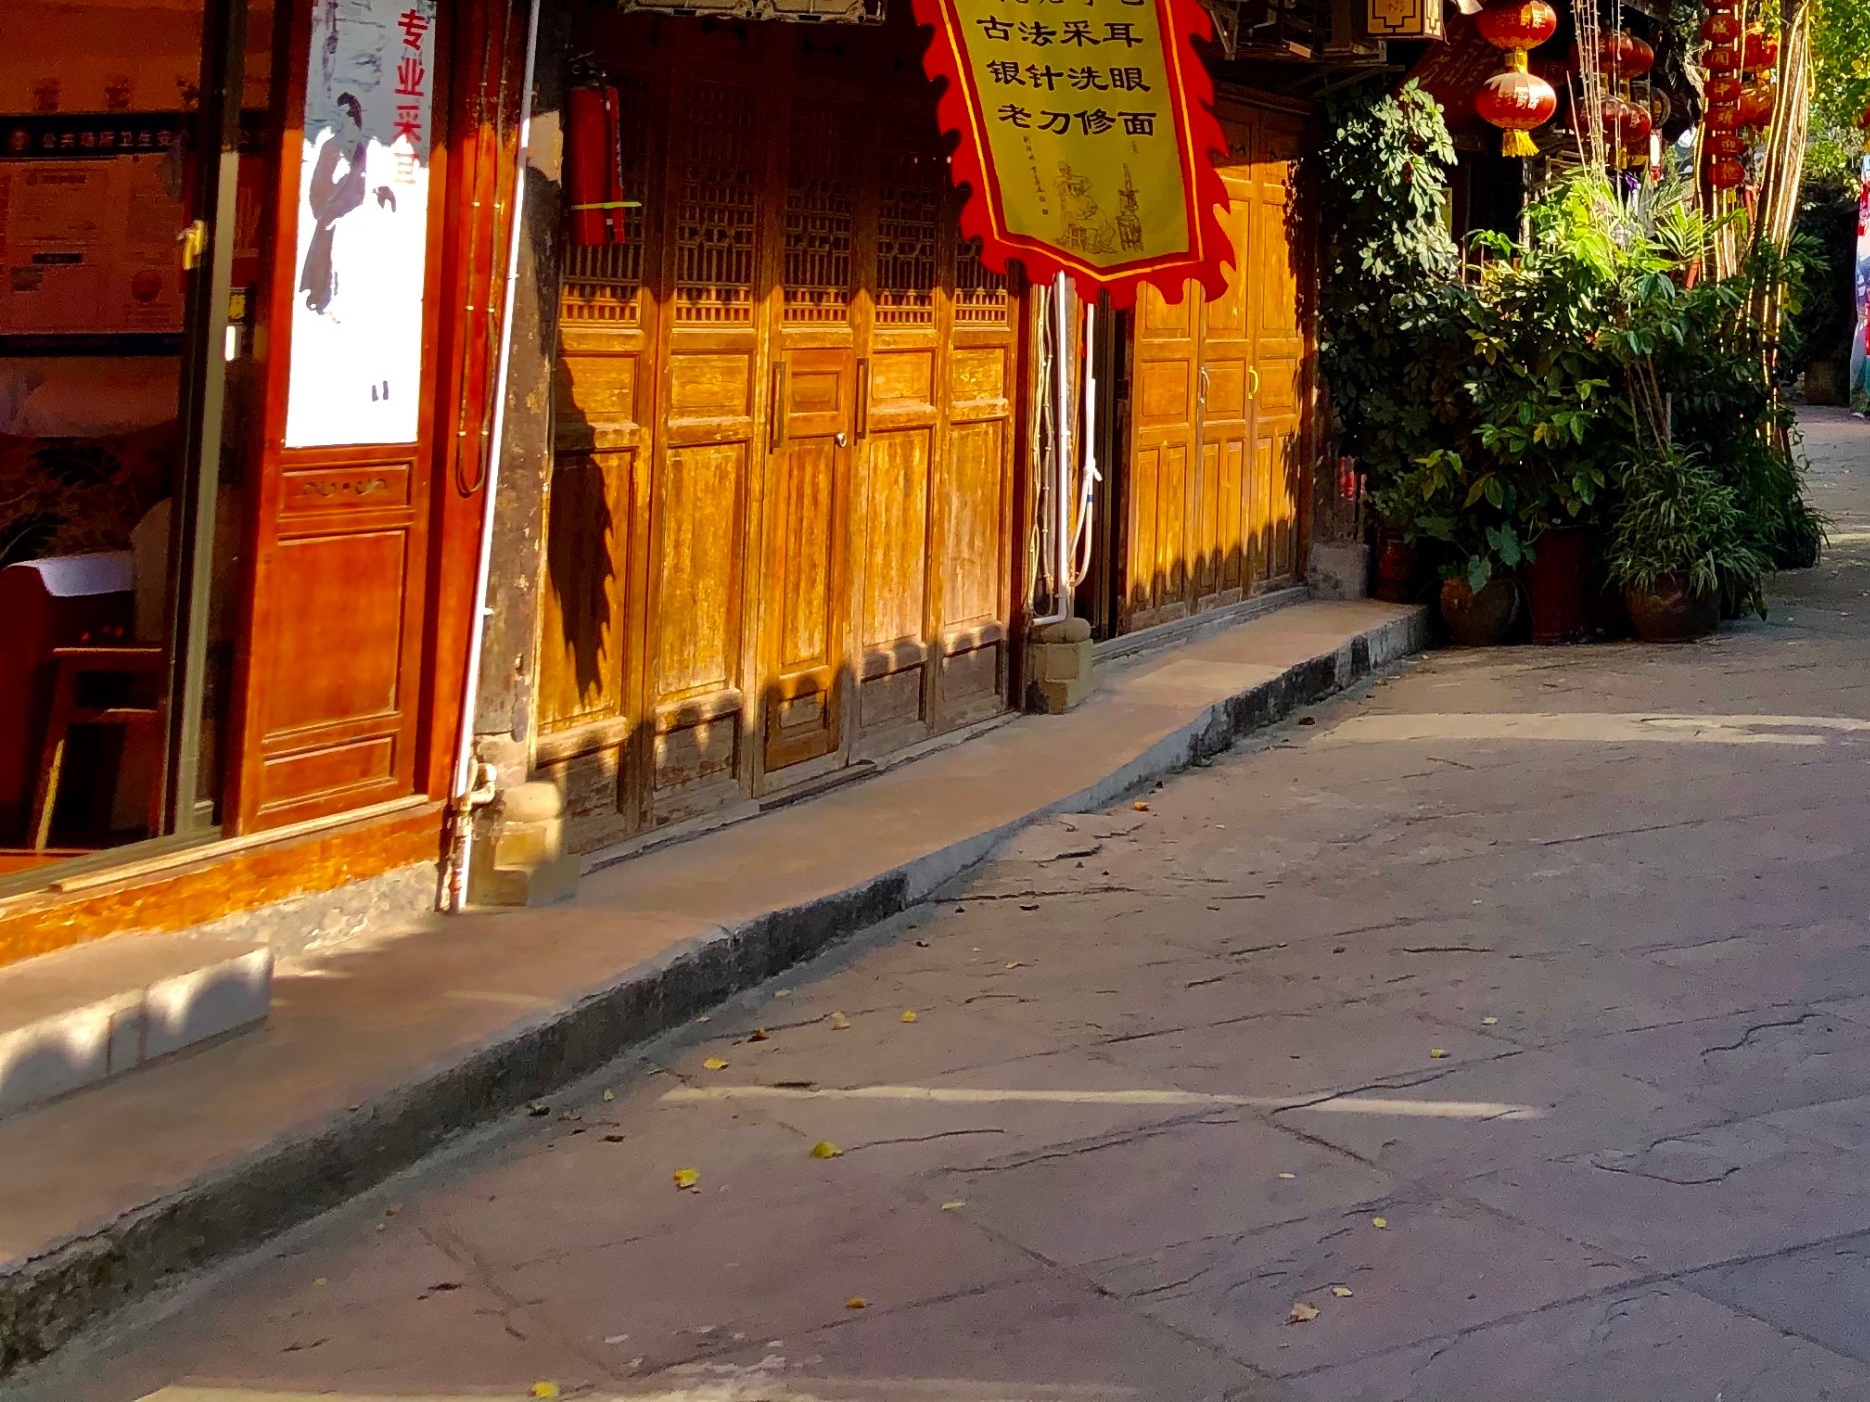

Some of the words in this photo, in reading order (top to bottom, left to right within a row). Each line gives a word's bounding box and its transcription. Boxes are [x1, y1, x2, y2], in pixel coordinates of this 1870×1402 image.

[976, 15, 1144, 49] 古法采耳
[986, 60, 1152, 92] 银针洗眼
[394, 9, 428, 184] 专业采耳
[998, 103, 1157, 137] 老刀修面
